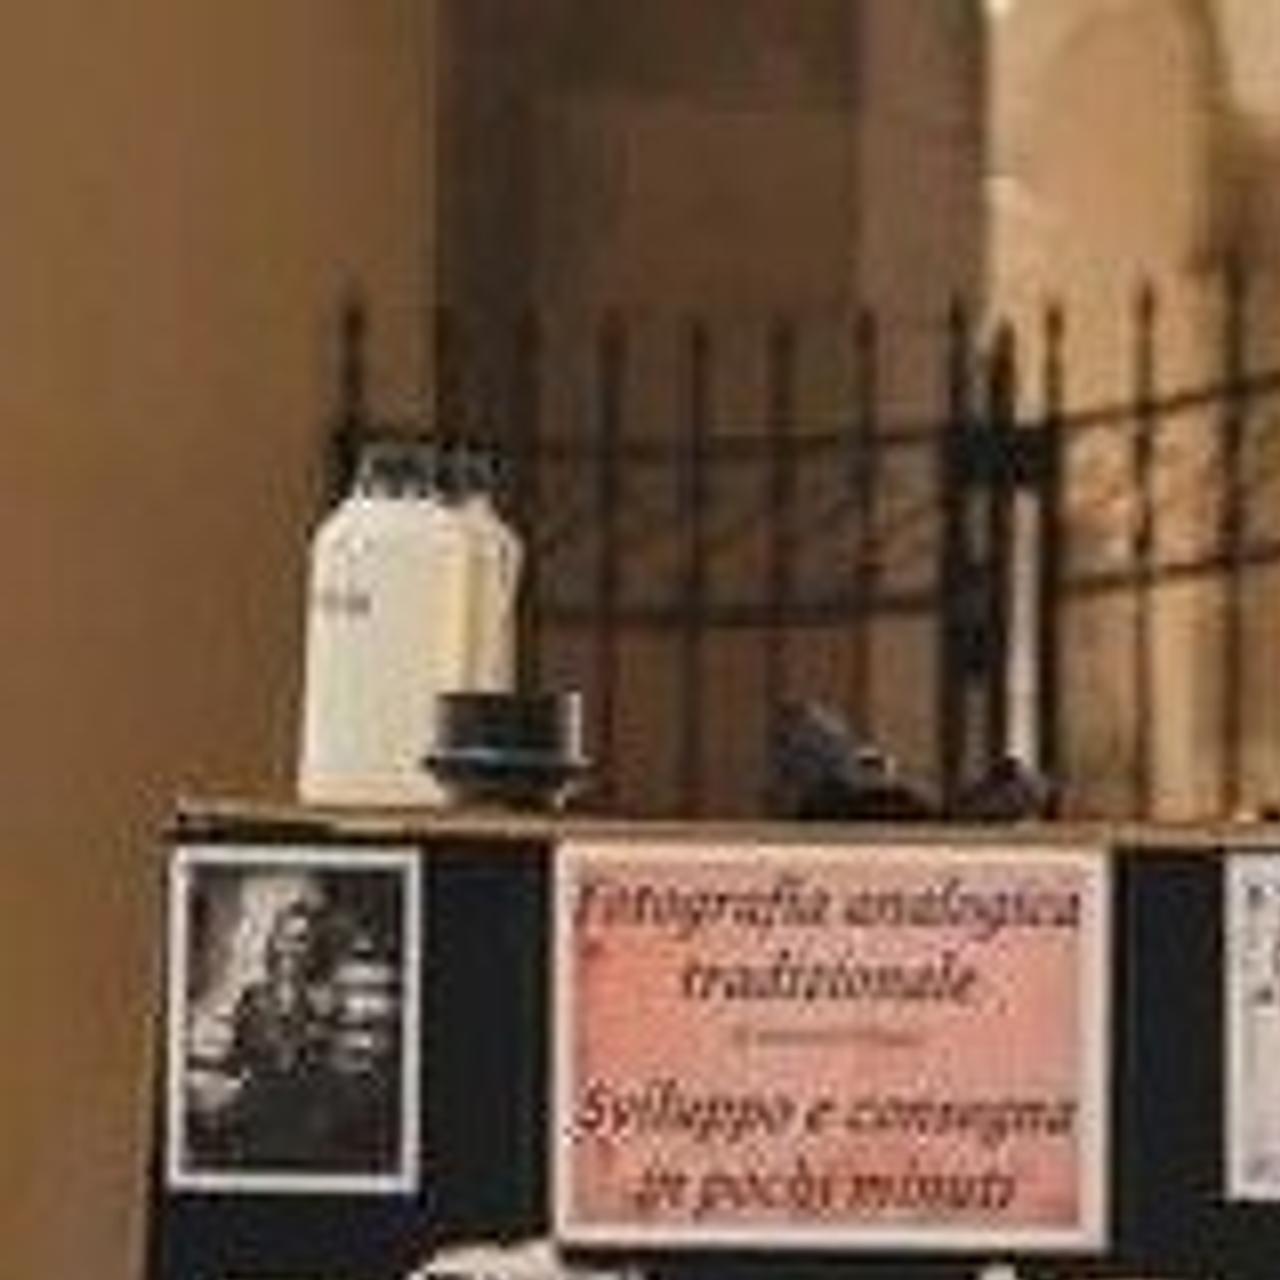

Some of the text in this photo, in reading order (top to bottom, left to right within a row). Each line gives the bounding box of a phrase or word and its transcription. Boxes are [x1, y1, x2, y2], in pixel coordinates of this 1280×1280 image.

[844, 876, 1082, 940] analogica
[682, 948, 978, 1004] tradizionale
[572, 1080, 1078, 1146] Sviluppo e consegna
[632, 1160, 1017, 1218] in pochi minuti
